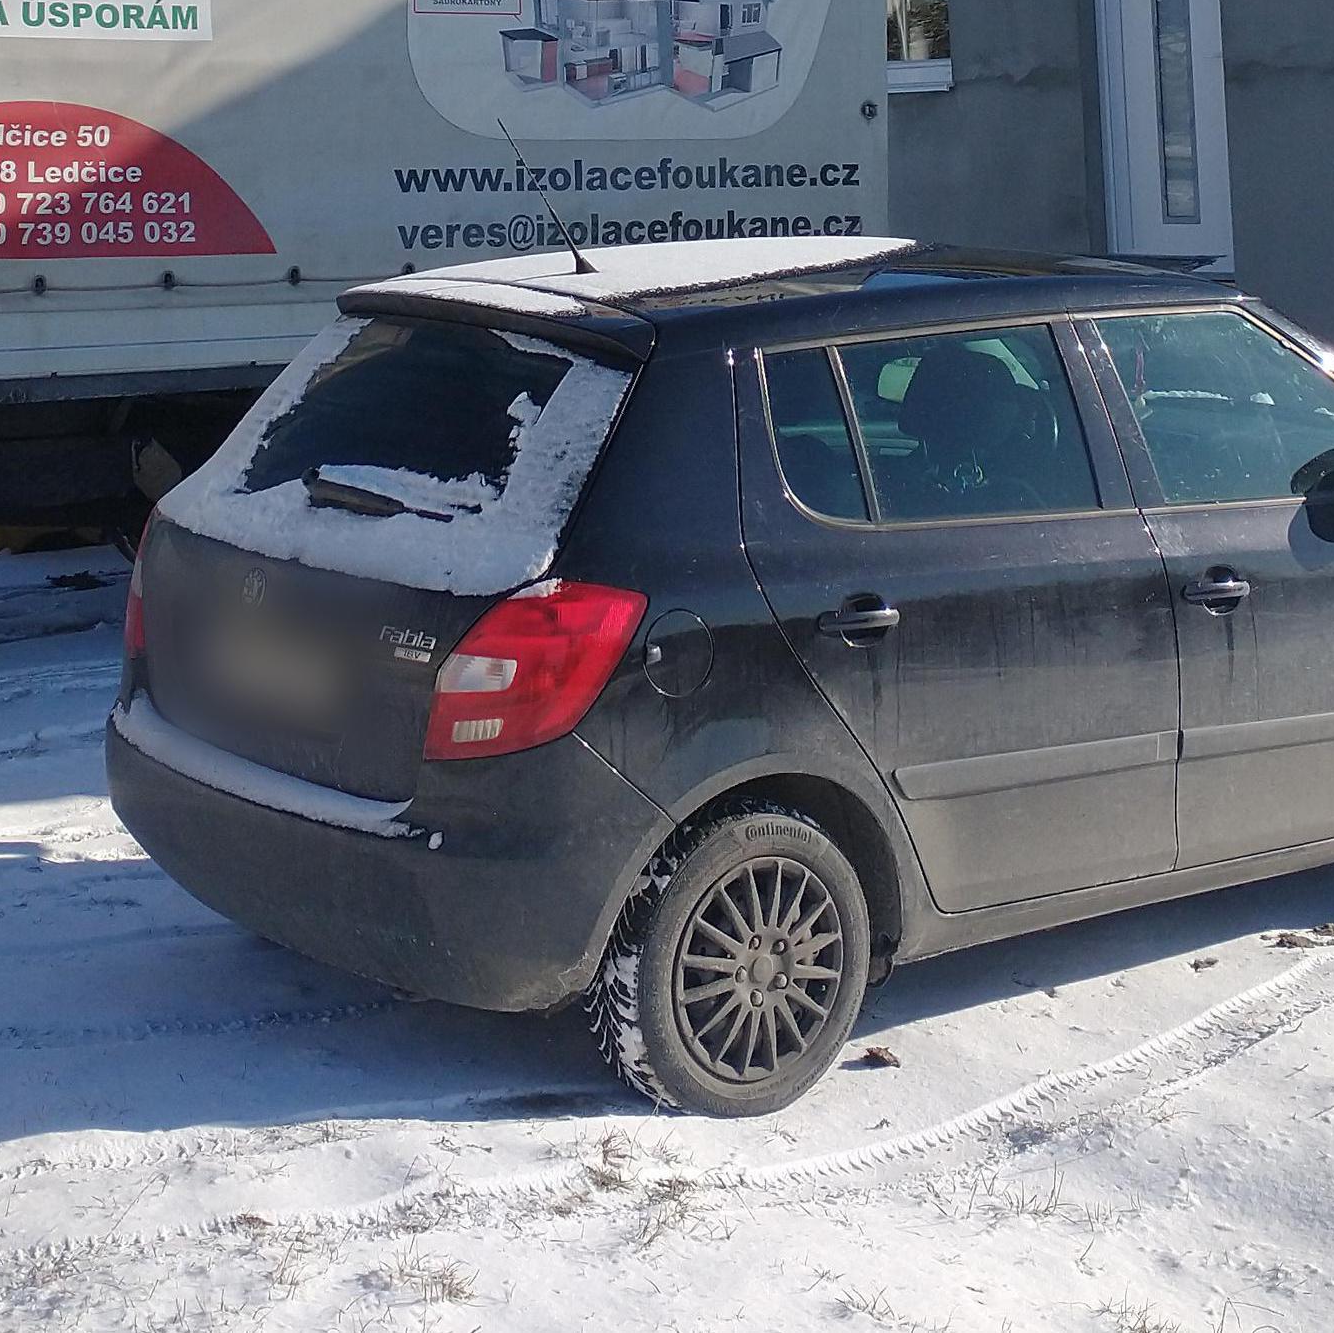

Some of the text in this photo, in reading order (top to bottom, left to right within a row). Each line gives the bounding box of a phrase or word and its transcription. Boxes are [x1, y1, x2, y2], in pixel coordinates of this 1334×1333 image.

[76, 125, 111, 147] 50
[26, 159, 143, 184] Ledčice
[394, 157, 860, 194] www.izolacefoukane.cz
[16, 192, 71, 216] 723
[81, 191, 133, 215] 764
[142, 191, 192, 215] 621
[18, 221, 72, 245] 739
[80, 221, 134, 245] 045
[143, 221, 196, 244] 032
[397, 210, 862, 252] veres@izolacefoukane.cz
[379, 625, 437, 650] Fabia
[745, 821, 812, 844] Continental
